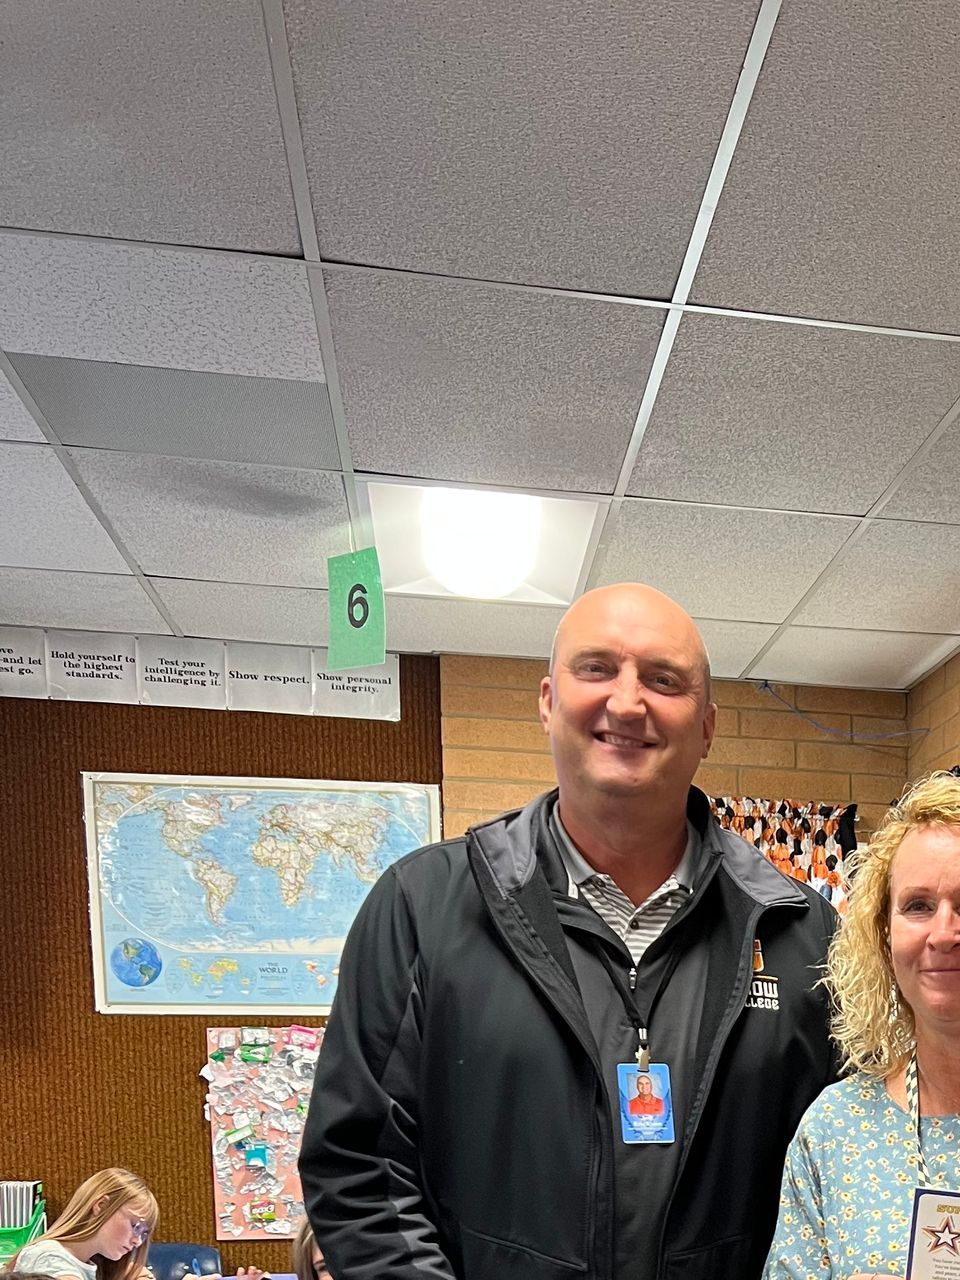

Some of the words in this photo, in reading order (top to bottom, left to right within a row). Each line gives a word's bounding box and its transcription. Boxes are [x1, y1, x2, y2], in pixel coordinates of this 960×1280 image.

[347, 583, 369, 629] 6
[28, 657, 42, 666] let
[51, 651, 75, 660] Hold
[77, 654, 123, 664] yourself
[125, 656, 136, 664] to
[158, 657, 179, 667] Test
[182, 660, 206, 669] your
[18, 668, 34, 676] go.
[63, 661, 81, 669] the
[84, 662, 123, 673] highest
[145, 666, 206, 678] intelligence
[208, 670, 221, 680] by
[65, 671, 123, 680] standards.
[144, 675, 207, 687] challenging
[210, 678, 222, 687] it.
[228, 670, 259, 681] Show
[263, 674, 310, 686] respect.
[316, 673, 343, 682] Show
[347, 676, 392, 686] personal
[331, 683, 379, 695] integrity.
